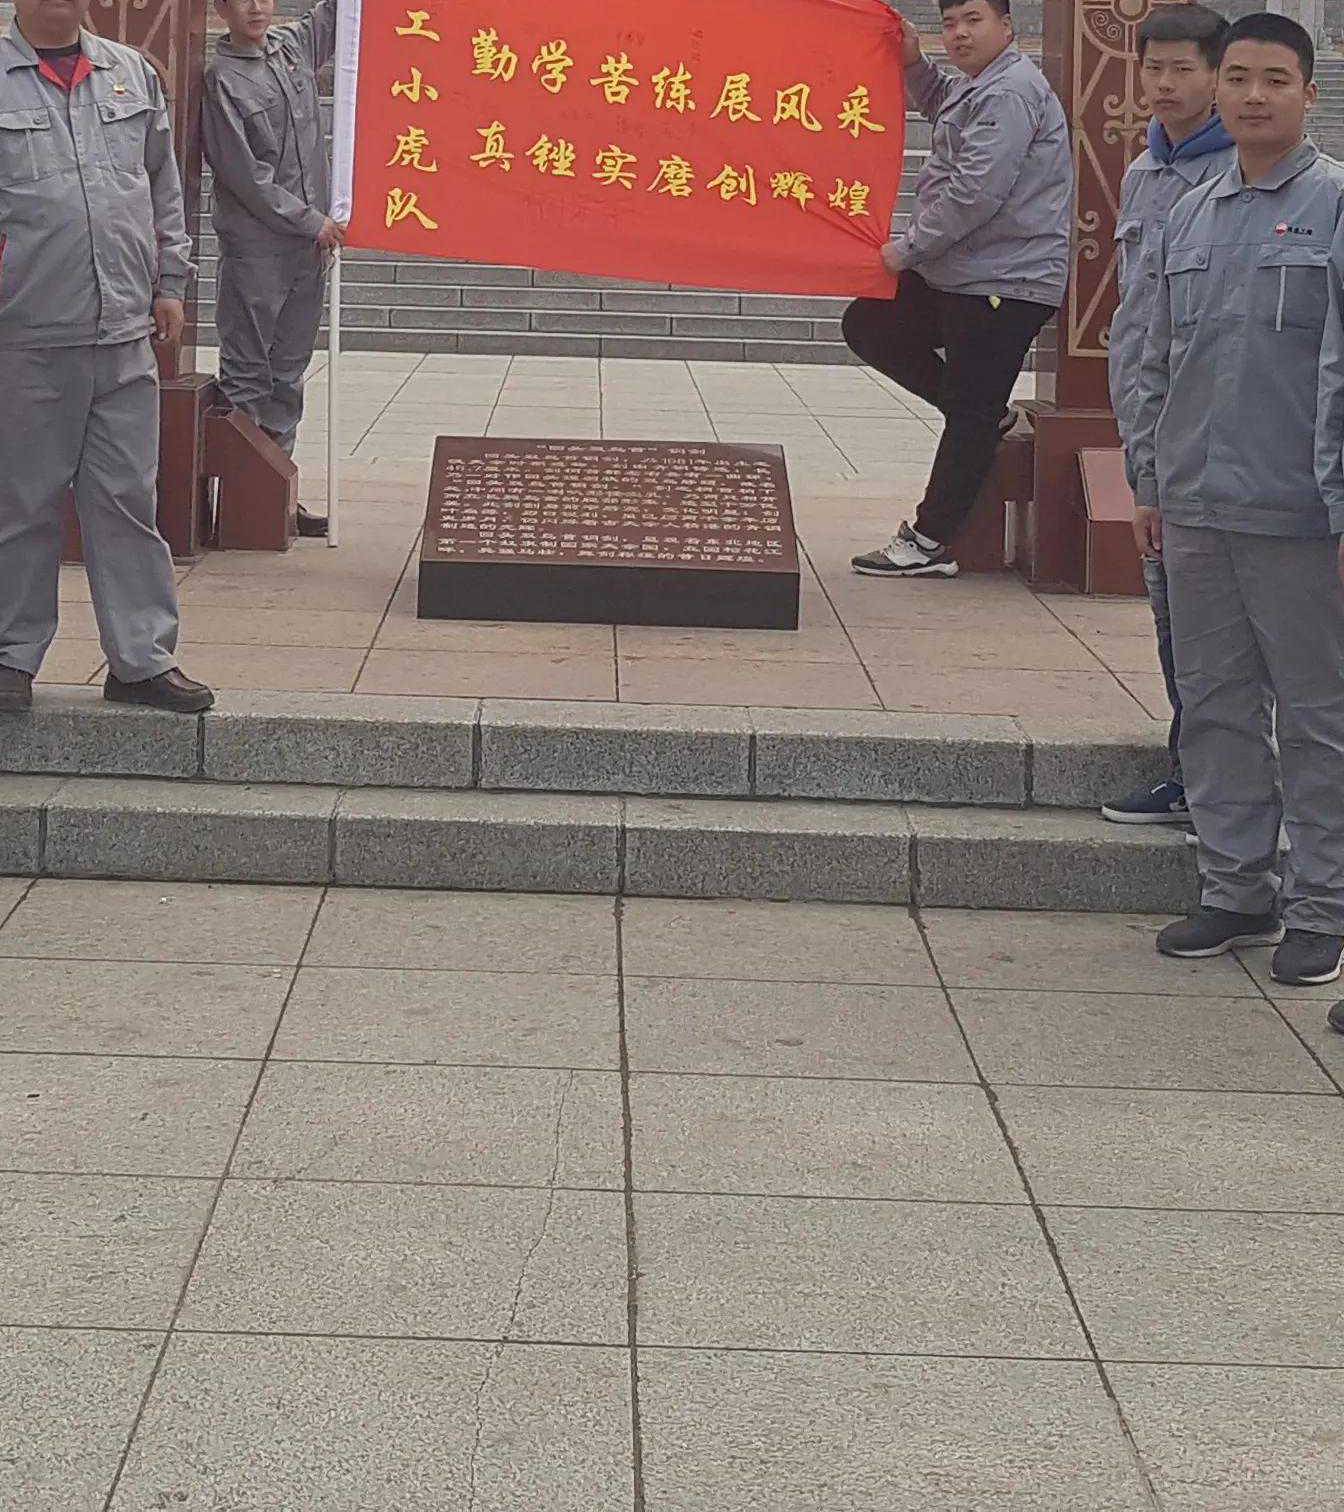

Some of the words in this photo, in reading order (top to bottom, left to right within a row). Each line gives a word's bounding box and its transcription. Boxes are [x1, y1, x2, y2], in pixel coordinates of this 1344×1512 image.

[471, 27, 886, 139] 勤学苦练展风采
[469, 120, 870, 217] 真锉实磨创辉煌
